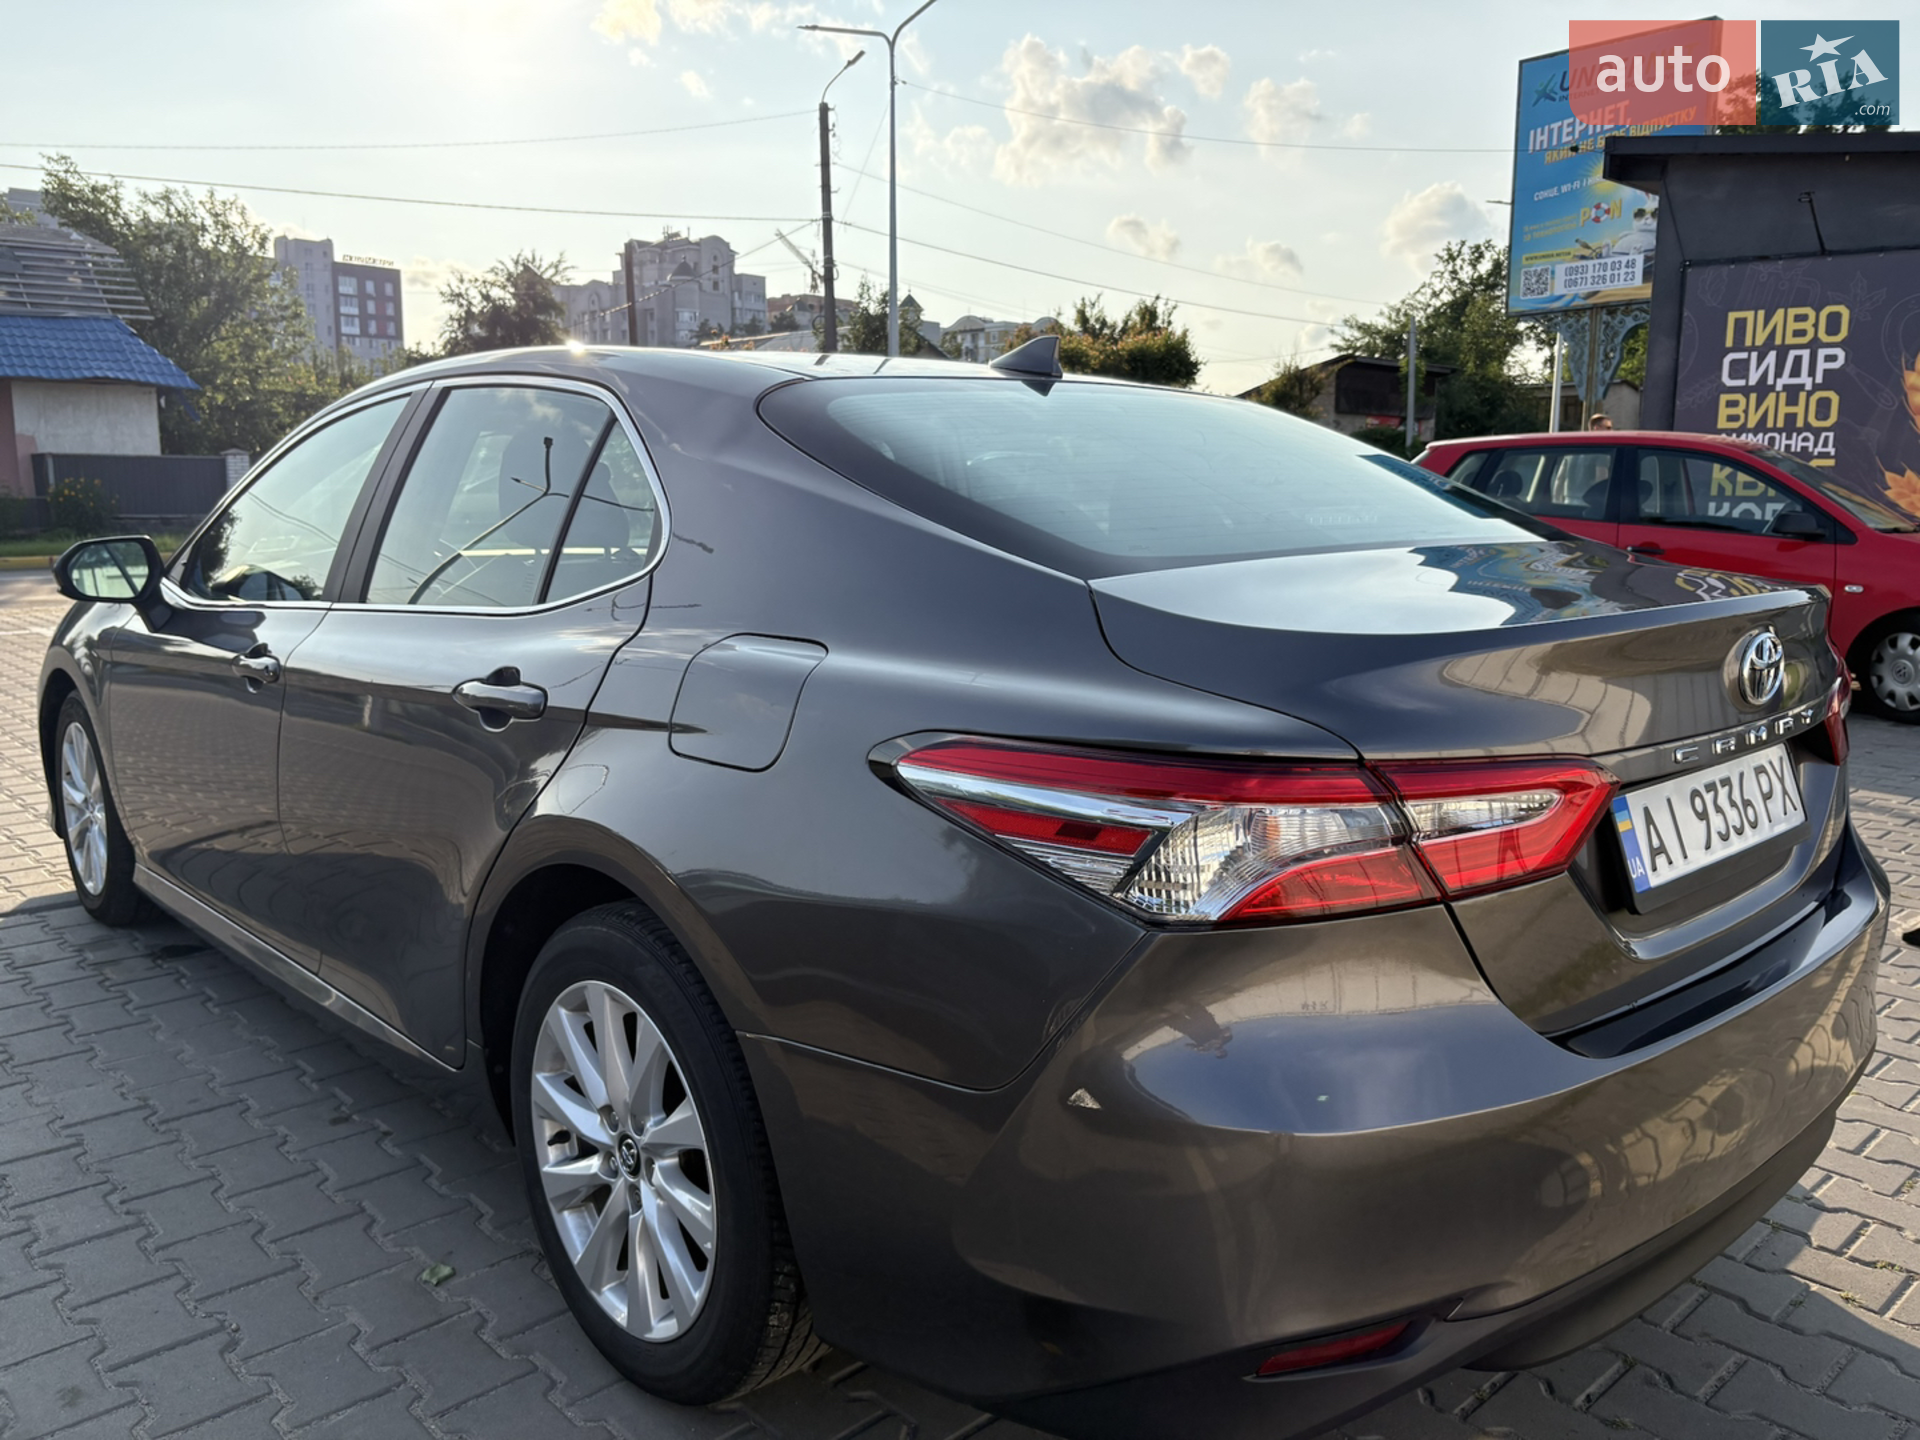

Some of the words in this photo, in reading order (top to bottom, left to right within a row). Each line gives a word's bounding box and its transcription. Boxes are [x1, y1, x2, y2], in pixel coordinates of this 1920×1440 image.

[1563, 276, 1588, 289] (067)
[1590, 273, 1608, 286] 326
[1609, 271, 1621, 283] 01
[1623, 270, 1636, 282] 23
[1564, 264, 1589, 278] (093)
[1592, 262, 1608, 274] 170
[1610, 260, 1622, 271] 03
[1624, 258, 1636, 270] 48
[1725, 304, 1850, 348] ПИВО
[1721, 347, 1846, 391] СИДР
[1717, 390, 1840, 430] ВИНО
[1672, 708, 1814, 764] CAMRY
[1643, 796, 1688, 873] AI
[1689, 769, 1759, 851] 9336
[1753, 755, 1798, 824] PX
[1629, 858, 1645, 879] UA
